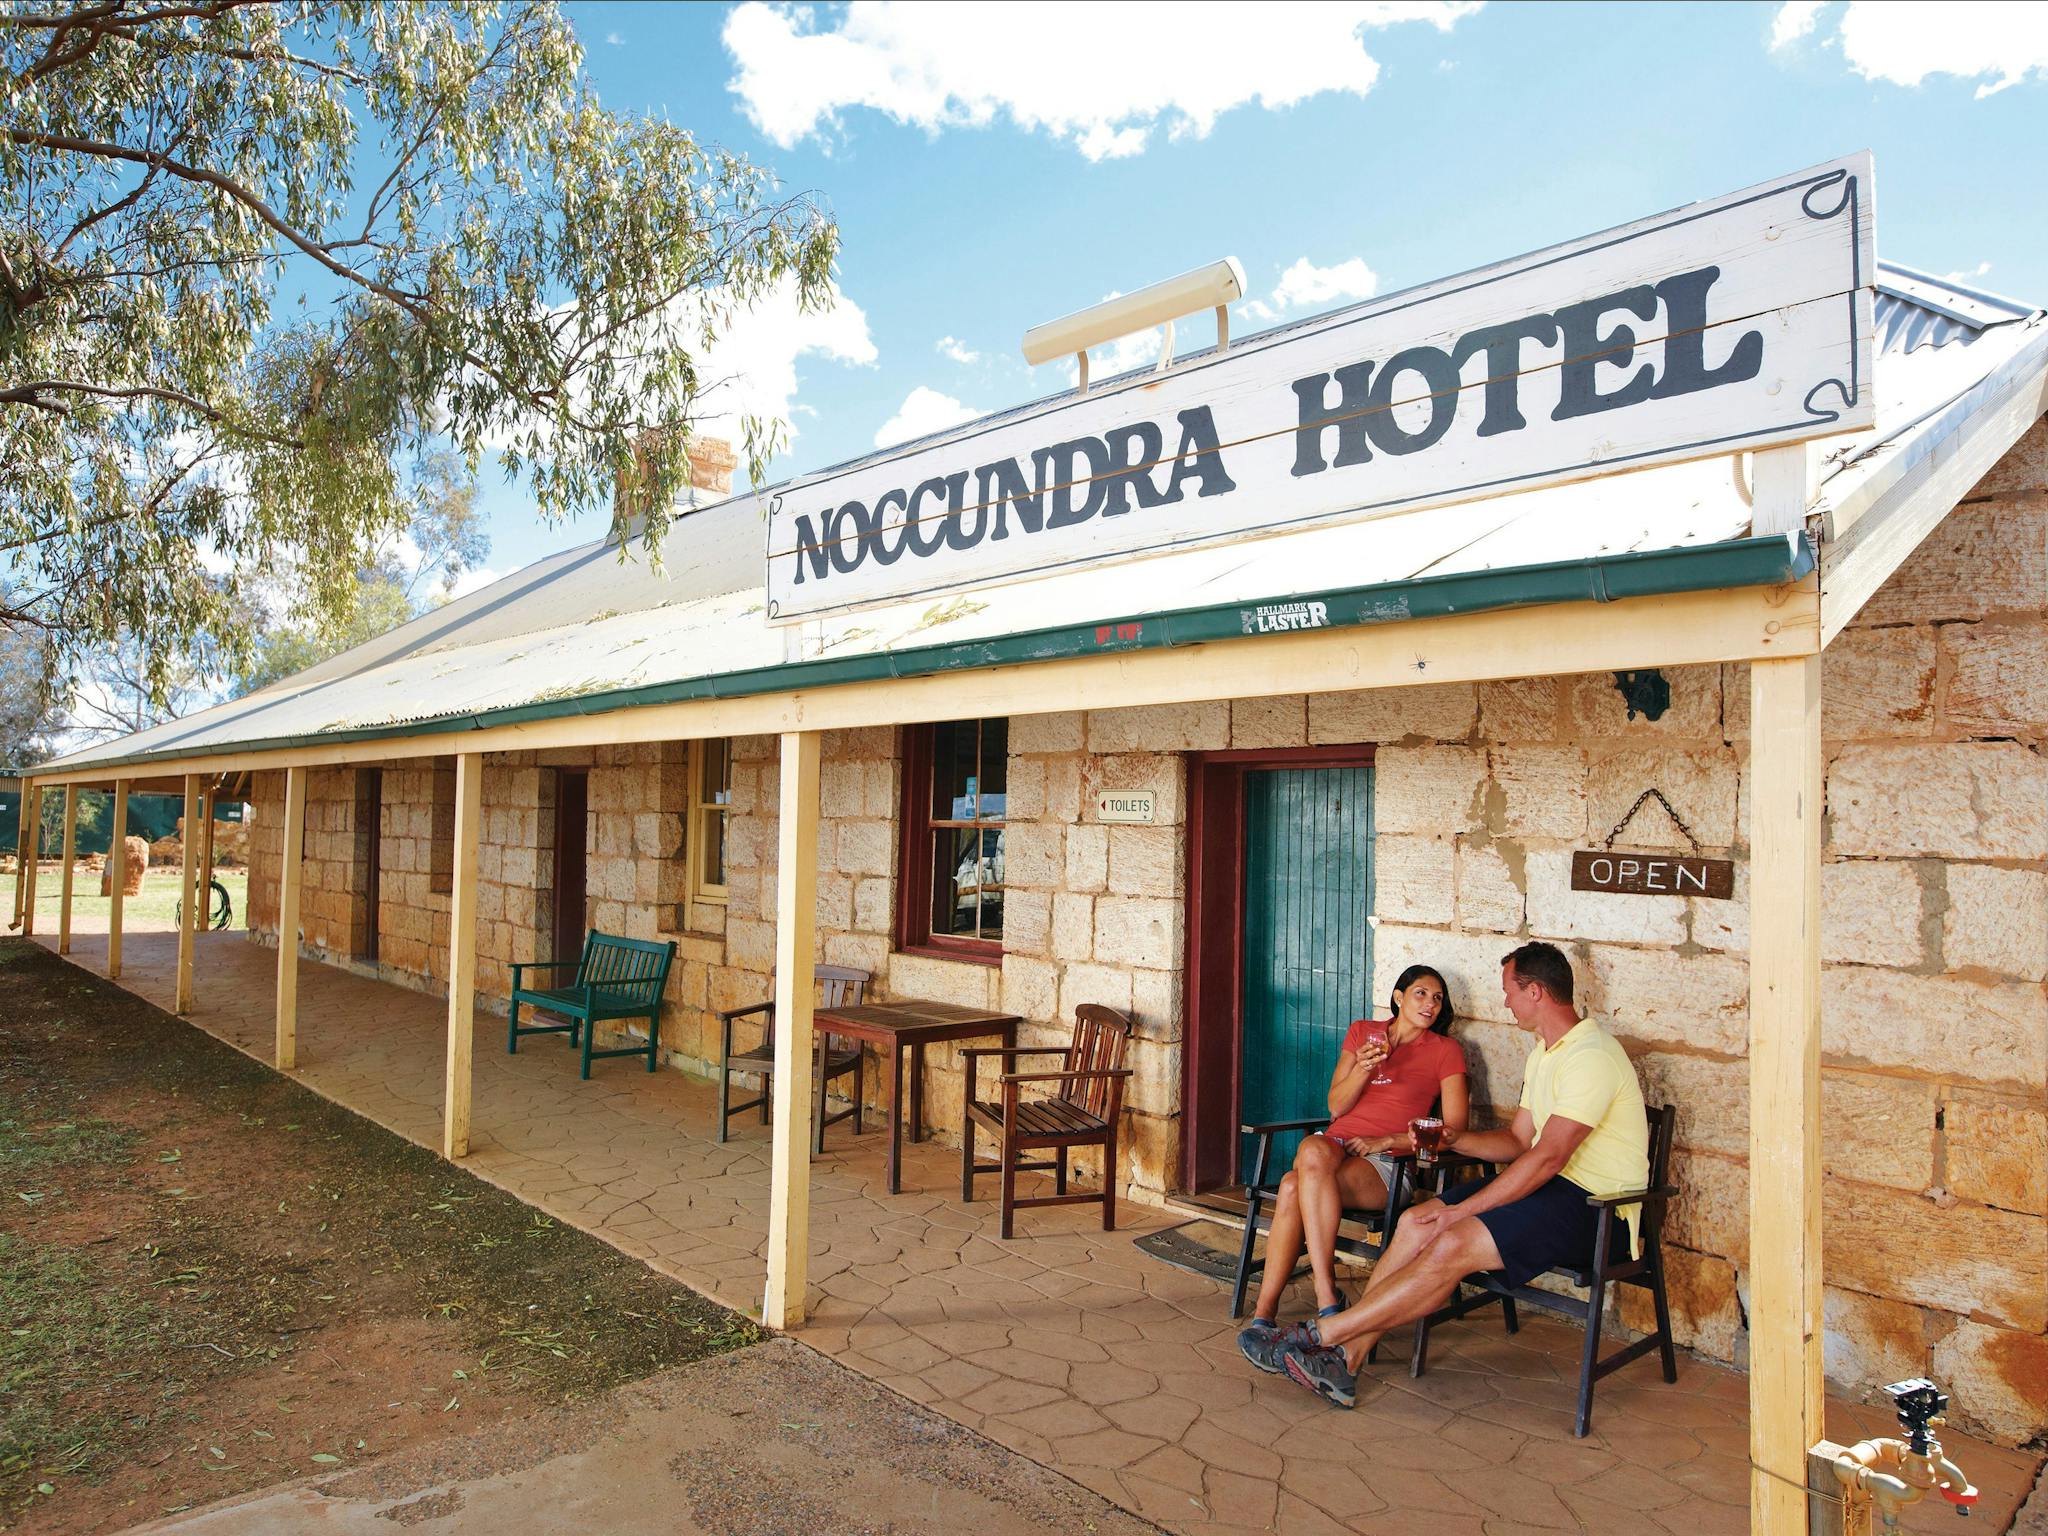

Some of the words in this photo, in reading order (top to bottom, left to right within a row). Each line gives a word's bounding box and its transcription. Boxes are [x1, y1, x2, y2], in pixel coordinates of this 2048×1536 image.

[793, 404, 1237, 584] NOCCUNDRA
[1290, 265, 1763, 477] HOTEL
[1256, 602, 1308, 617] HALLMARK
[1109, 799, 1150, 812] TOILETS
[1590, 859, 1707, 891] OPEN
